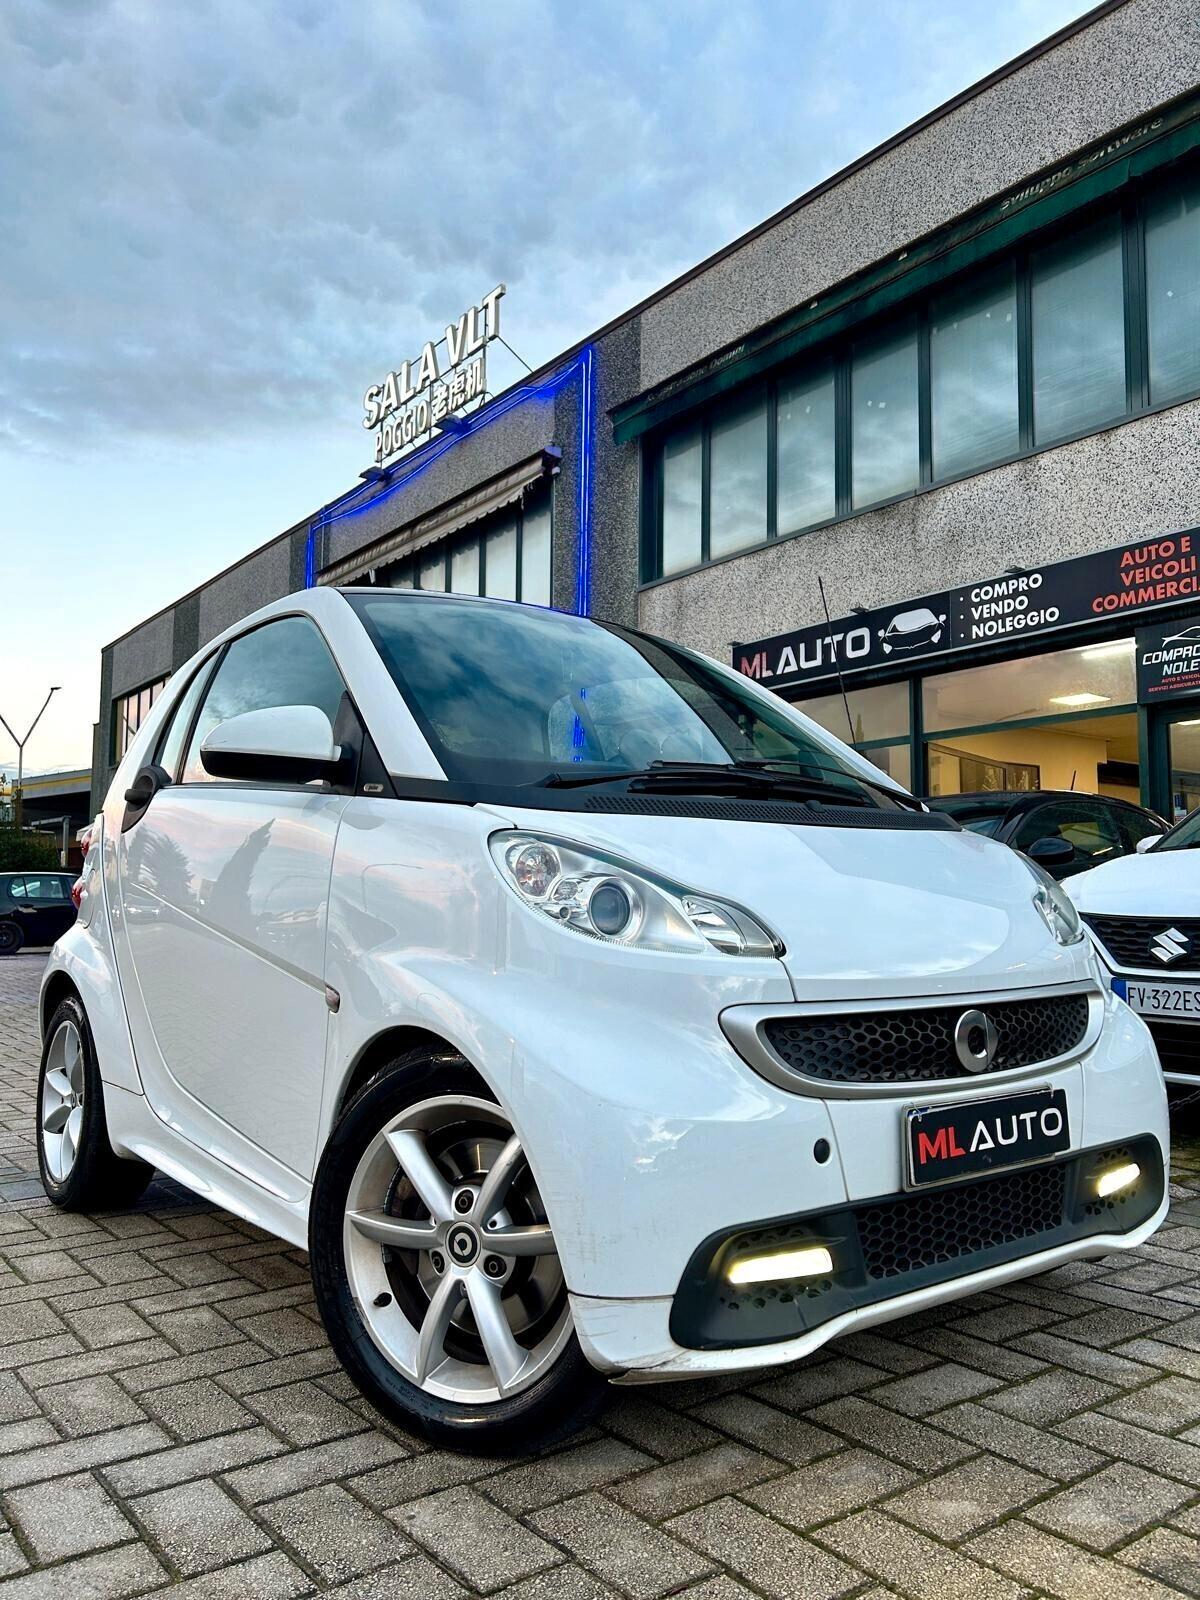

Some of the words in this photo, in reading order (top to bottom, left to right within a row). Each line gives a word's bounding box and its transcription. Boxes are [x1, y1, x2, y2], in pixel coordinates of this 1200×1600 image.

[362, 341, 440, 430] SALA
[445, 283, 506, 368] VLT
[431, 357, 486, 427] 老虎机
[375, 400, 431, 463] POGGIO
[1120, 541, 1175, 568] AUTO
[1181, 536, 1191, 552] E
[1120, 556, 1196, 586] VEICOLI
[971, 573, 1043, 602] COMPRO
[1092, 576, 1200, 612] COMMERCI
[971, 595, 1028, 620] VENDO
[972, 607, 1060, 639] NOLEGGIO
